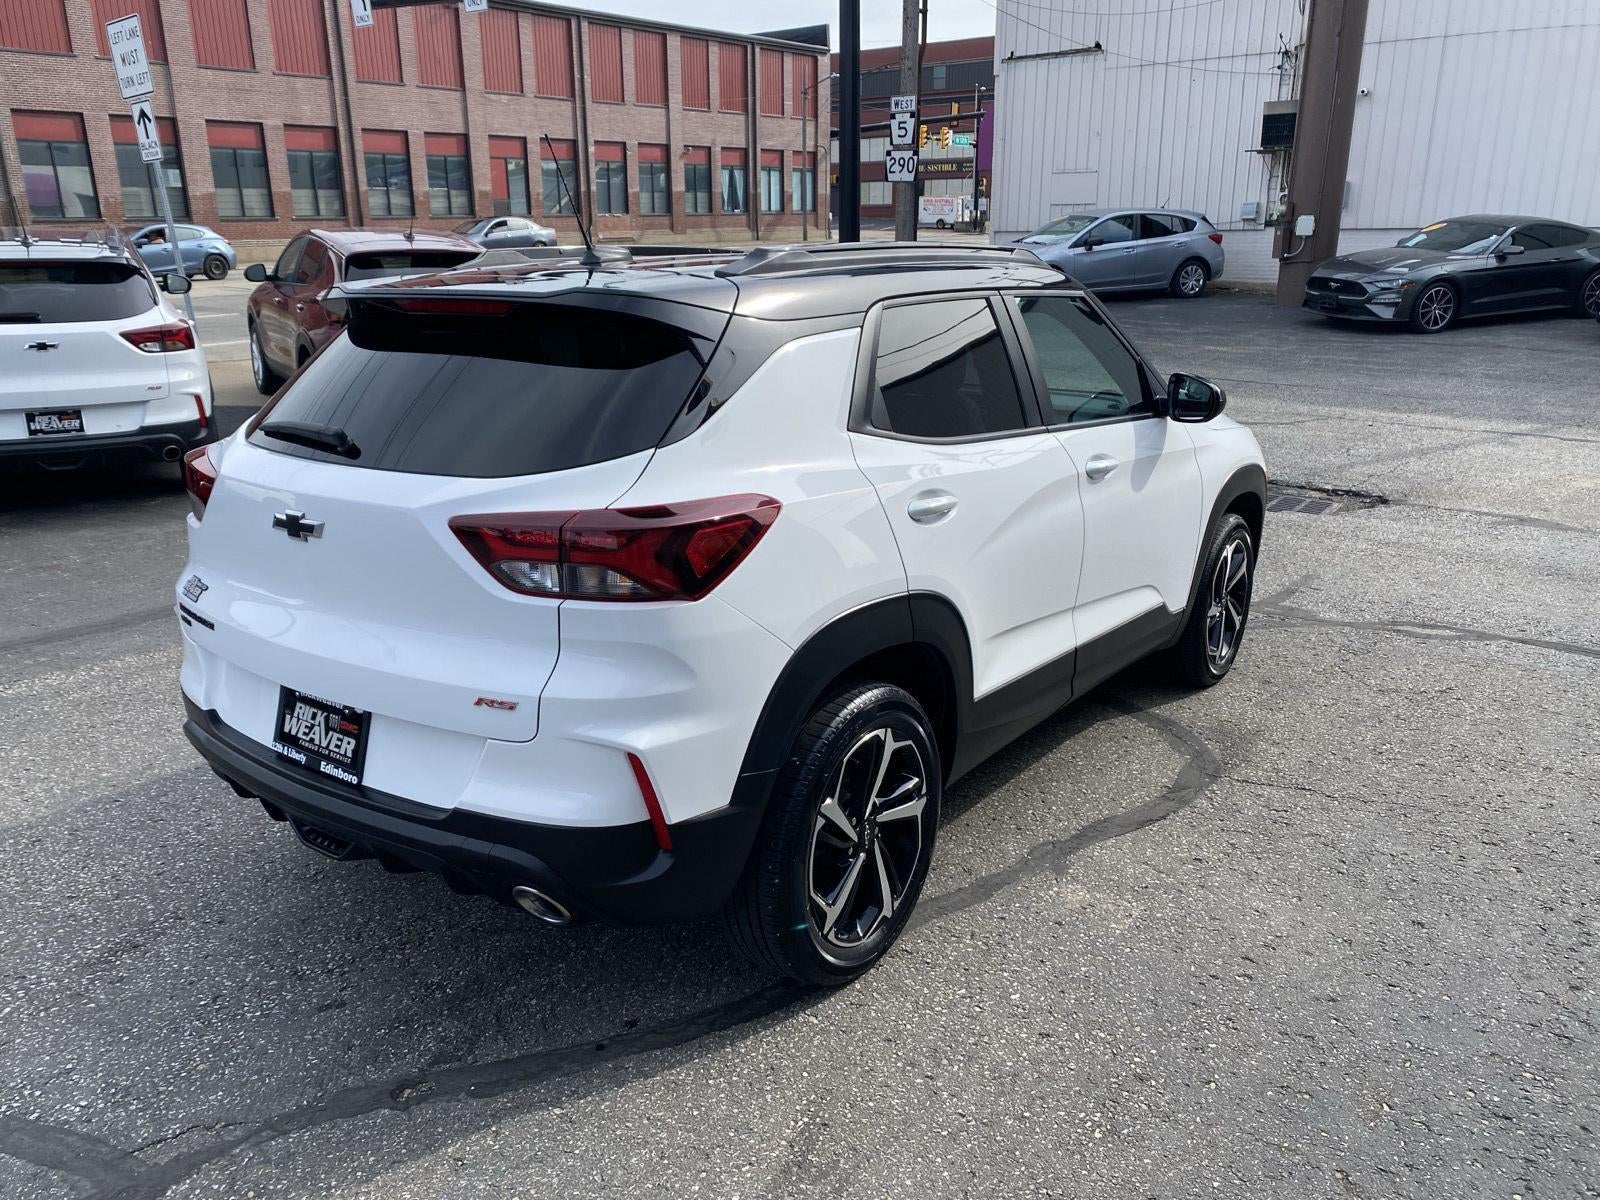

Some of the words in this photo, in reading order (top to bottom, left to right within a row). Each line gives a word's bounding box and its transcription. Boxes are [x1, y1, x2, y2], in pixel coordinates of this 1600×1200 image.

[356, 14, 370, 23] ONLY
[111, 30, 124, 45] LEFT
[125, 25, 140, 41] LANE
[120, 48, 139, 67] MUST
[120, 74, 135, 89] TURN
[135, 71, 150, 86] LEFT
[893, 99, 913, 110] WEST
[897, 121, 908, 138] 5
[888, 157, 915, 174] 290
[29, 419, 80, 431] WEAVER
[473, 697, 519, 711] RS
[293, 701, 328, 726] RICK
[283, 714, 356, 758] WEAVER
[271, 740, 284, 753] 12th
[288, 748, 307, 764] Liberty
[298, 739, 319, 751] FAMOUS
[319, 747, 329, 755] FOR
[330, 751, 352, 764] SERVICE
[320, 761, 358, 784] Edinboro
